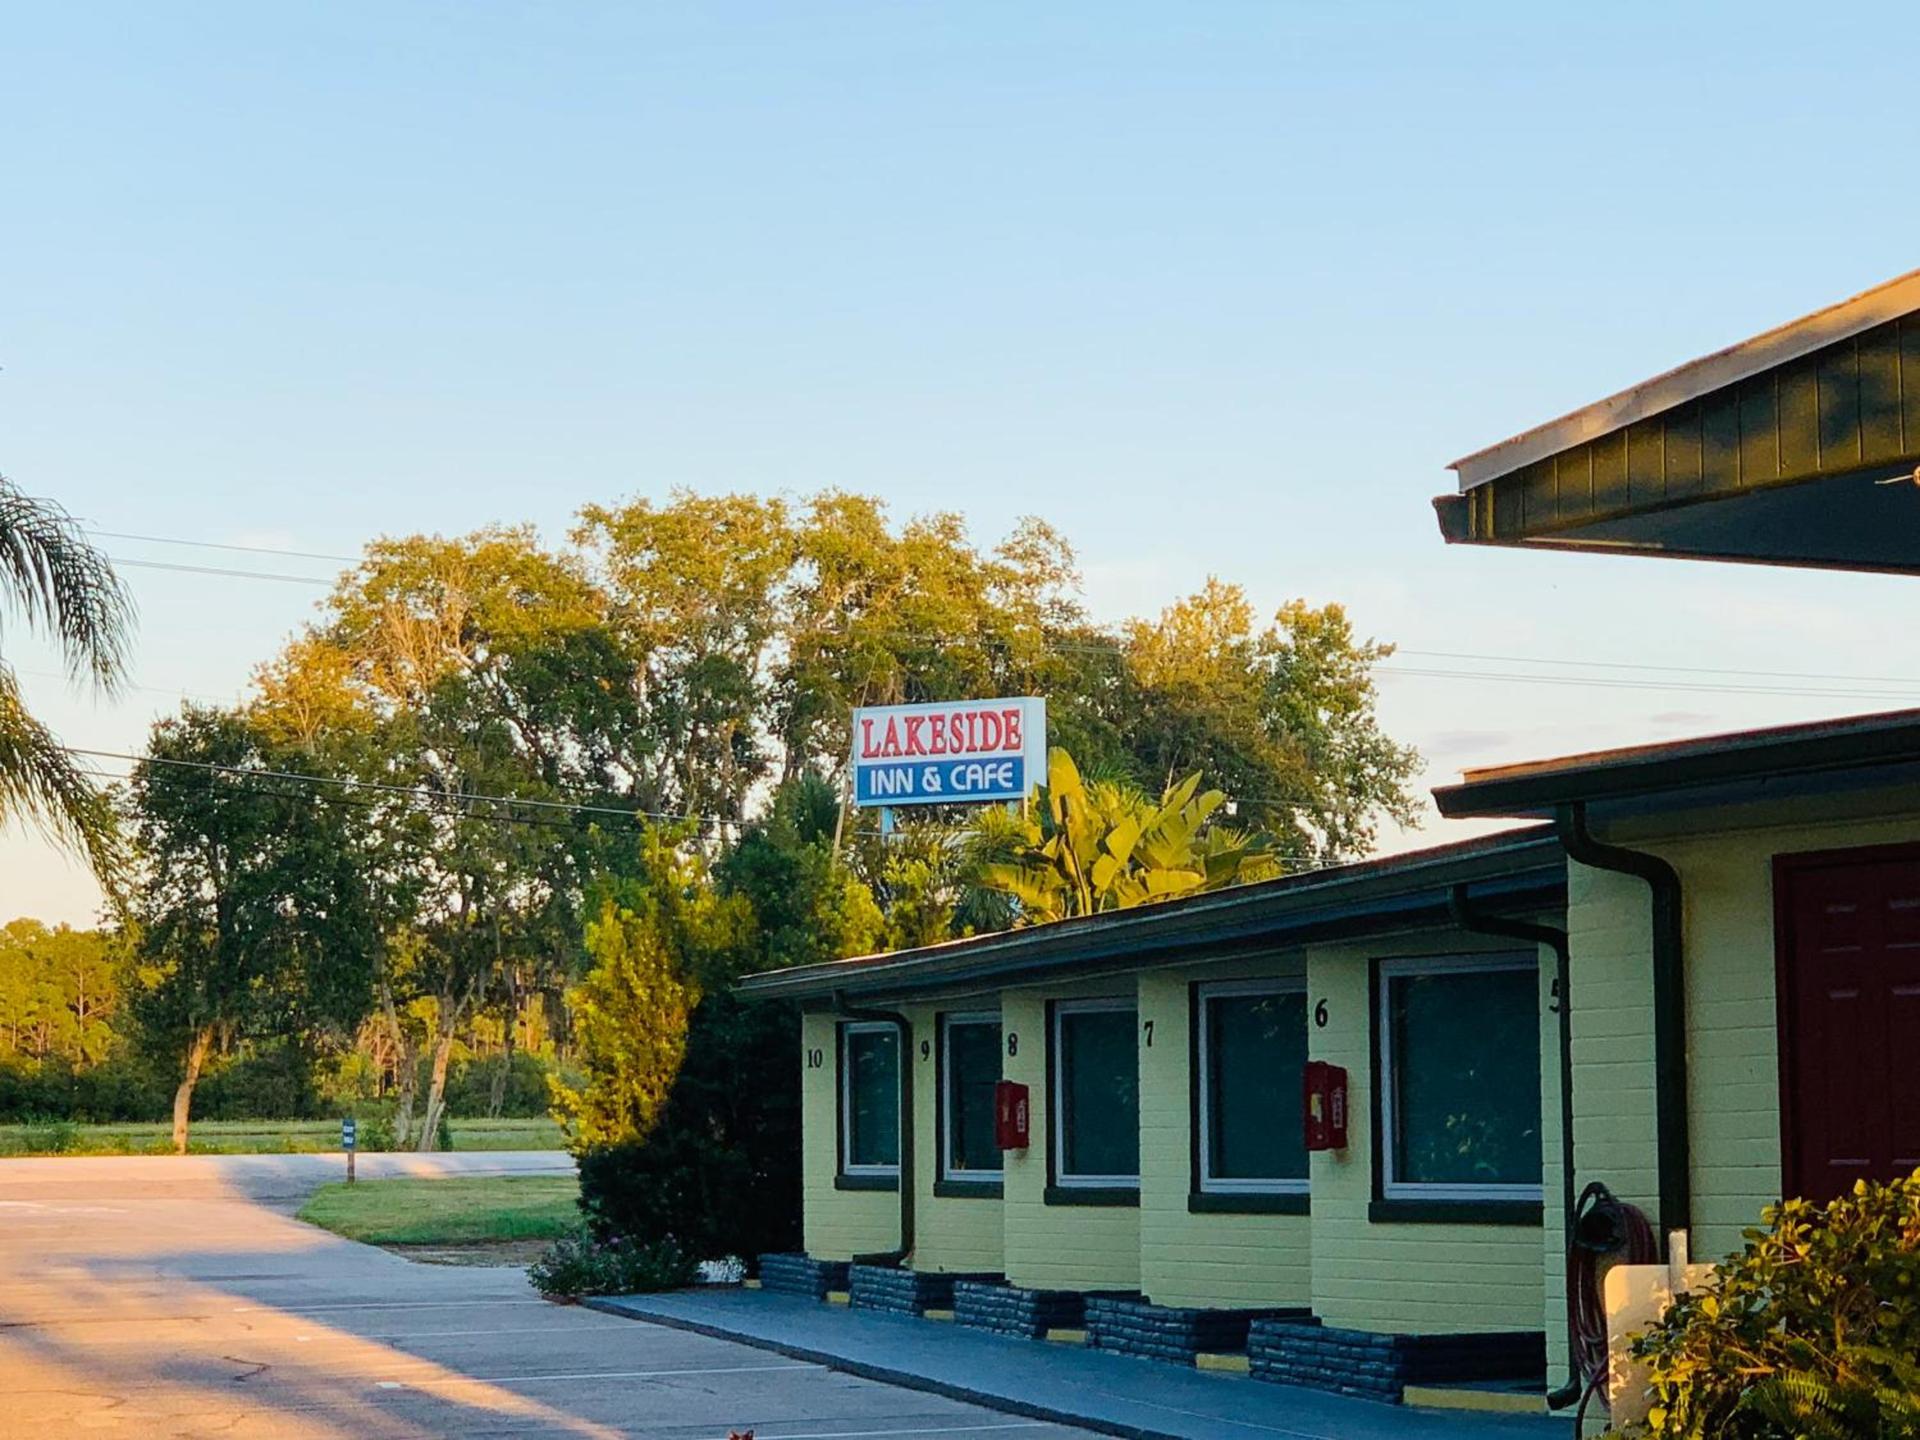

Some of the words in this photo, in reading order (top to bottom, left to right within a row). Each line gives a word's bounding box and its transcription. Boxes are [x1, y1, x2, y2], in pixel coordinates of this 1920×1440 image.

[861, 709, 1022, 758] LAKESIDE
[870, 767, 914, 795] INN
[922, 766, 942, 792] &
[951, 761, 1013, 791] CAFE
[1315, 998, 1328, 1028] 6
[1008, 1033, 1018, 1057] 8
[1144, 1021, 1154, 1047] 7
[807, 1049, 823, 1069] 10
[921, 1041, 930, 1062] 9
